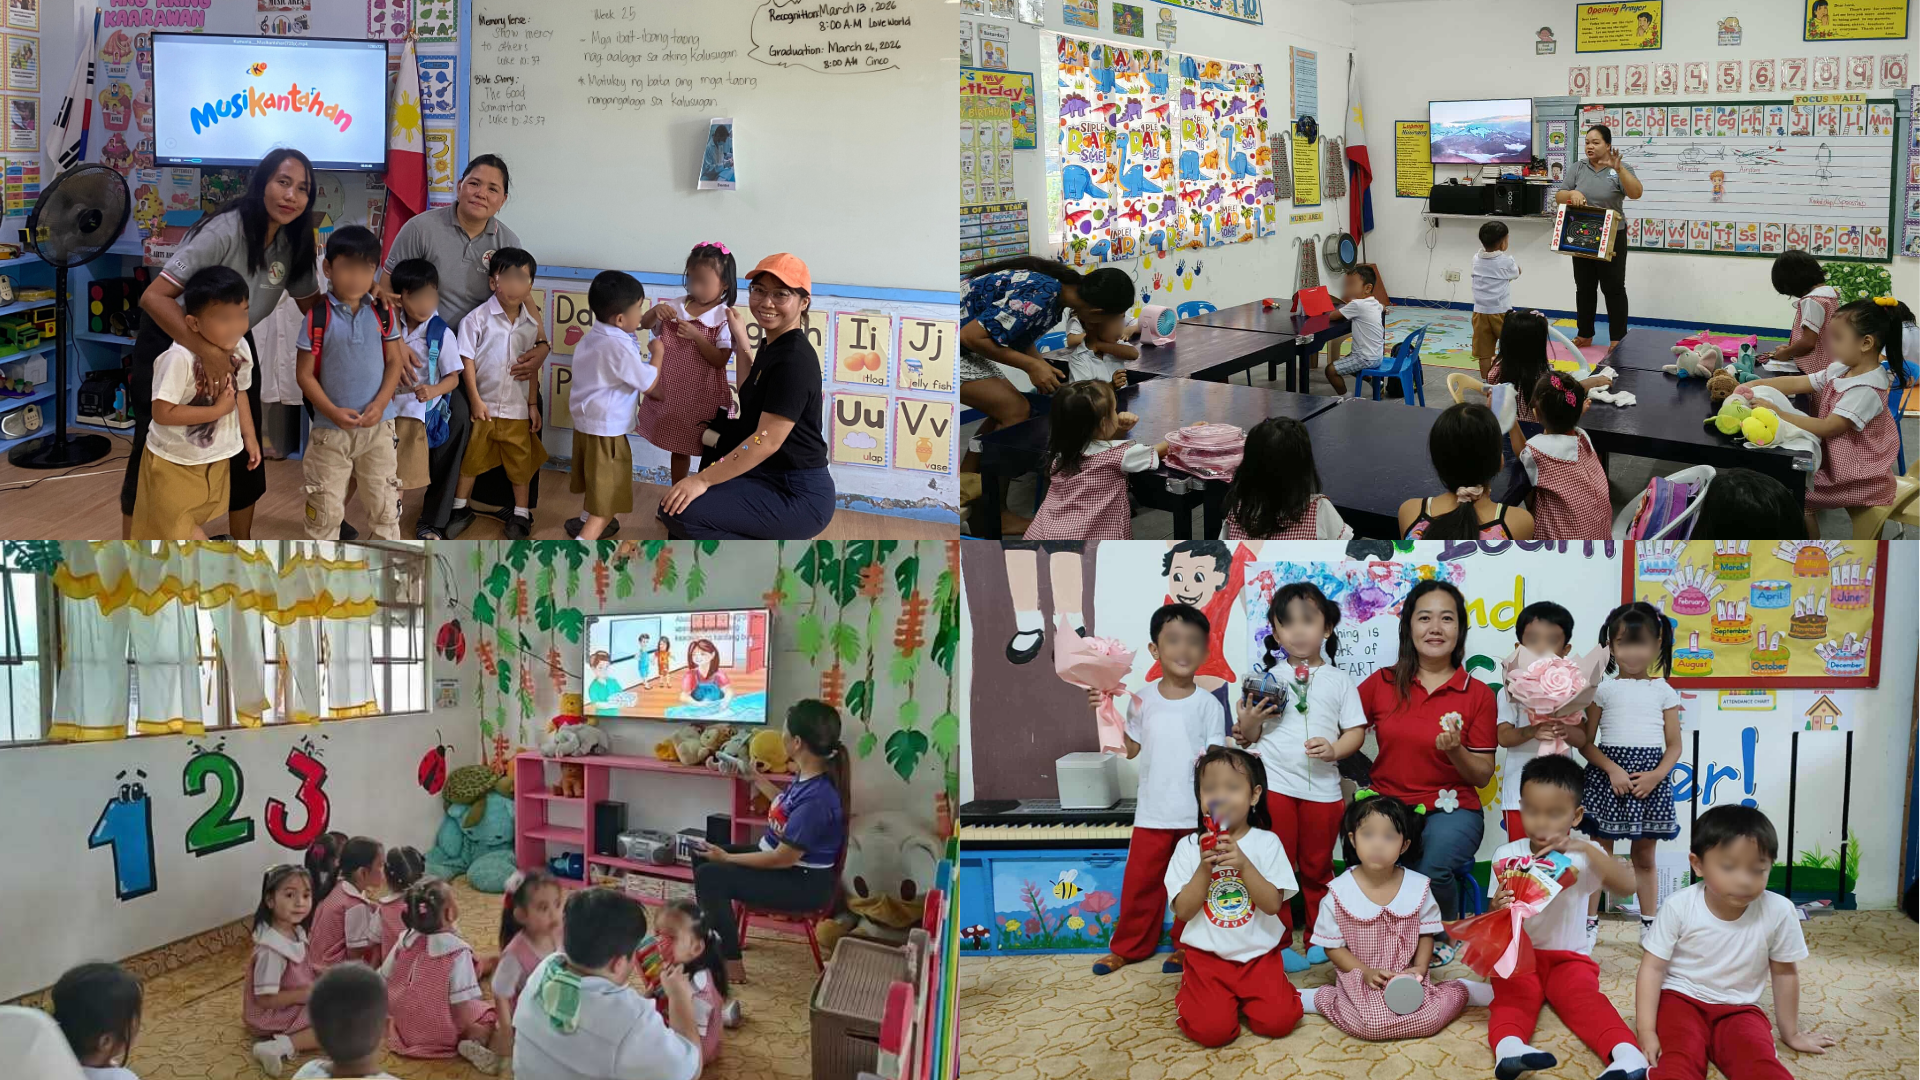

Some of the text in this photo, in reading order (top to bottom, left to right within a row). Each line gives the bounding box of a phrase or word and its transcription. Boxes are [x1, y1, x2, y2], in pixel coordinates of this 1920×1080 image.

[594, 6, 636, 20] Week 25
[819, 4, 854, 17] March
[857, 4, 867, 13] 13
[1587, 4, 1647, 15] Opening Prayer
[104, 9, 205, 27] KAARAWAN
[478, 15, 506, 28] Memory
[819, 20, 841, 31] 8:00
[525, 29, 553, 41] mercy
[481, 42, 492, 51] to
[769, 44, 824, 57] Graduation:
[828, 41, 861, 53] March
[880, 40, 901, 50] 2026
[647, 52, 658, 62] sa
[824, 56, 889, 69] 8:00 Cinco
[474, 75, 491, 84] Bible
[647, 74, 670, 87] bata
[983, 73, 1005, 85] my
[1574, 73, 1586, 89] 0
[1630, 71, 1642, 87] 2
[1661, 71, 1672, 87] 3
[1690, 70, 1702, 86] 4
[1724, 68, 1735, 85] 5
[1756, 67, 1768, 85] 6
[1788, 66, 1801, 83] 7
[1820, 64, 1832, 81] 8
[1853, 64, 1866, 81] 9
[1884, 62, 1903, 80] 10
[1796, 94, 1861, 103] FOCUS WALL
[190, 83, 353, 135] Musikantahan
[968, 106, 1010, 118] BIRTHDAY
[1604, 113, 1893, 130] Bb Cc Dd Ee Ff Gg Hh Ii Jj Kk Ll Mm
[1553, 211, 1564, 246] SOLAR
[1600, 214, 1611, 252] SYSTEM
[1644, 226, 1663, 237] Ww
[1668, 227, 1685, 238] Vv
[1690, 228, 1709, 239] Uu
[1715, 229, 1732, 241] Tt
[1739, 230, 1756, 242] Ss
[1764, 231, 1781, 242] Rr
[1787, 232, 1809, 247] Qq
[1814, 232, 1832, 248] Pp
[1838, 232, 1860, 245] Oo
[1864, 234, 1886, 247] Nn
[850, 318, 877, 350] Ii
[909, 322, 943, 361] Jj
[863, 374, 884, 386] itlog
[909, 379, 952, 391] jelly fish
[837, 400, 884, 429] Uu
[901, 401, 948, 438] Vv
[863, 453, 883, 463] ulap
[925, 463, 947, 472] vase
[1720, 563, 1745, 571] March
[1803, 560, 1820, 568] May
[1644, 566, 1673, 575] January
[1465, 574, 1525, 631] nd
[1678, 597, 1705, 607] February
[1757, 591, 1782, 602] April
[1837, 592, 1861, 602] June
[1336, 627, 1359, 643] hing
[1714, 627, 1750, 636] September
[1793, 625, 1825, 633] November
[1335, 643, 1377, 657] ork of
[1338, 661, 1375, 676] EART
[1677, 660, 1708, 670] August
[1752, 662, 1787, 671] October
[1830, 661, 1862, 669] December
[184, 750, 254, 857] 2
[265, 747, 331, 850] 3
[89, 795, 157, 900] 1
